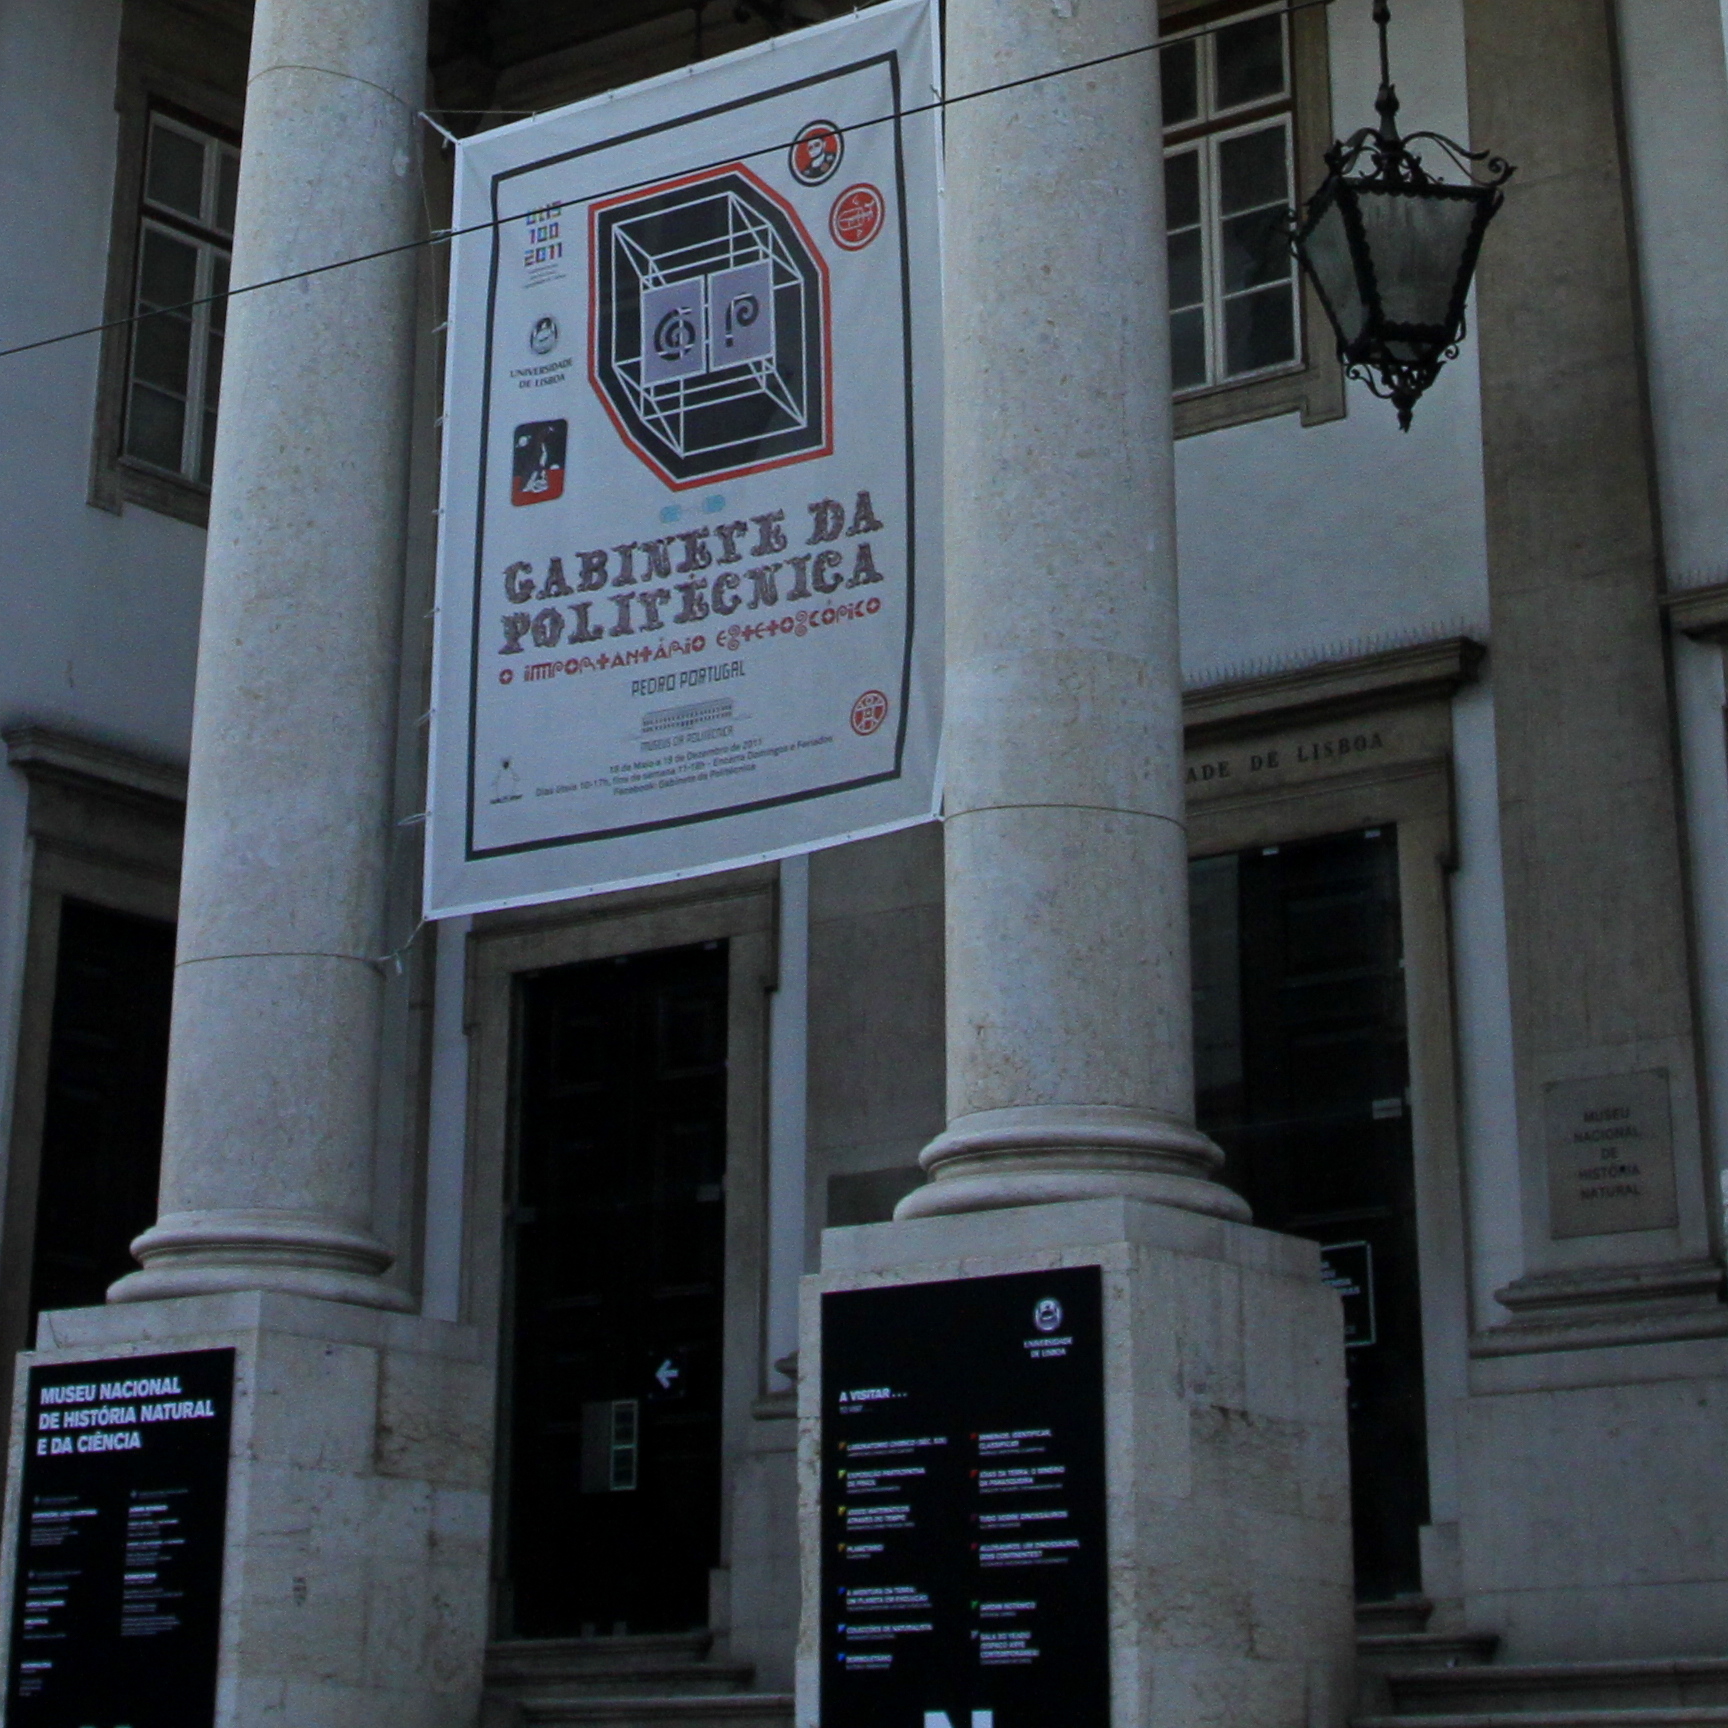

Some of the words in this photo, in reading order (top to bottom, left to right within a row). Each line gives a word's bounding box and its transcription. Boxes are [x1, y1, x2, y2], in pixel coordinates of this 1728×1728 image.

[524, 242, 562, 267] 2011
[510, 357, 572, 378] UNIVERSIDADE
[519, 377, 531, 389] DE
[535, 373, 566, 388] LISBOA
[503, 509, 788, 604] GABINETE
[806, 490, 884, 546] DA
[498, 543, 884, 654] POLITÉCNICA
[631, 670, 675, 698] PEDRO
[680, 660, 746, 689] PORTUGAL
[1251, 751, 1279, 772] DE
[1297, 732, 1383, 763] LISBOA
[40, 1383, 97, 1406] MUSEU
[99, 1376, 182, 1400] NACIONAL
[839, 1391, 849, 1403] A
[38, 1412, 60, 1430] DE
[63, 1405, 137, 1428] HISTÓRIA
[140, 1399, 215, 1422] NATURAL
[36, 1438, 48, 1456] E
[50, 1436, 73, 1454] DA
[76, 1430, 142, 1453] CIÊNCIA
